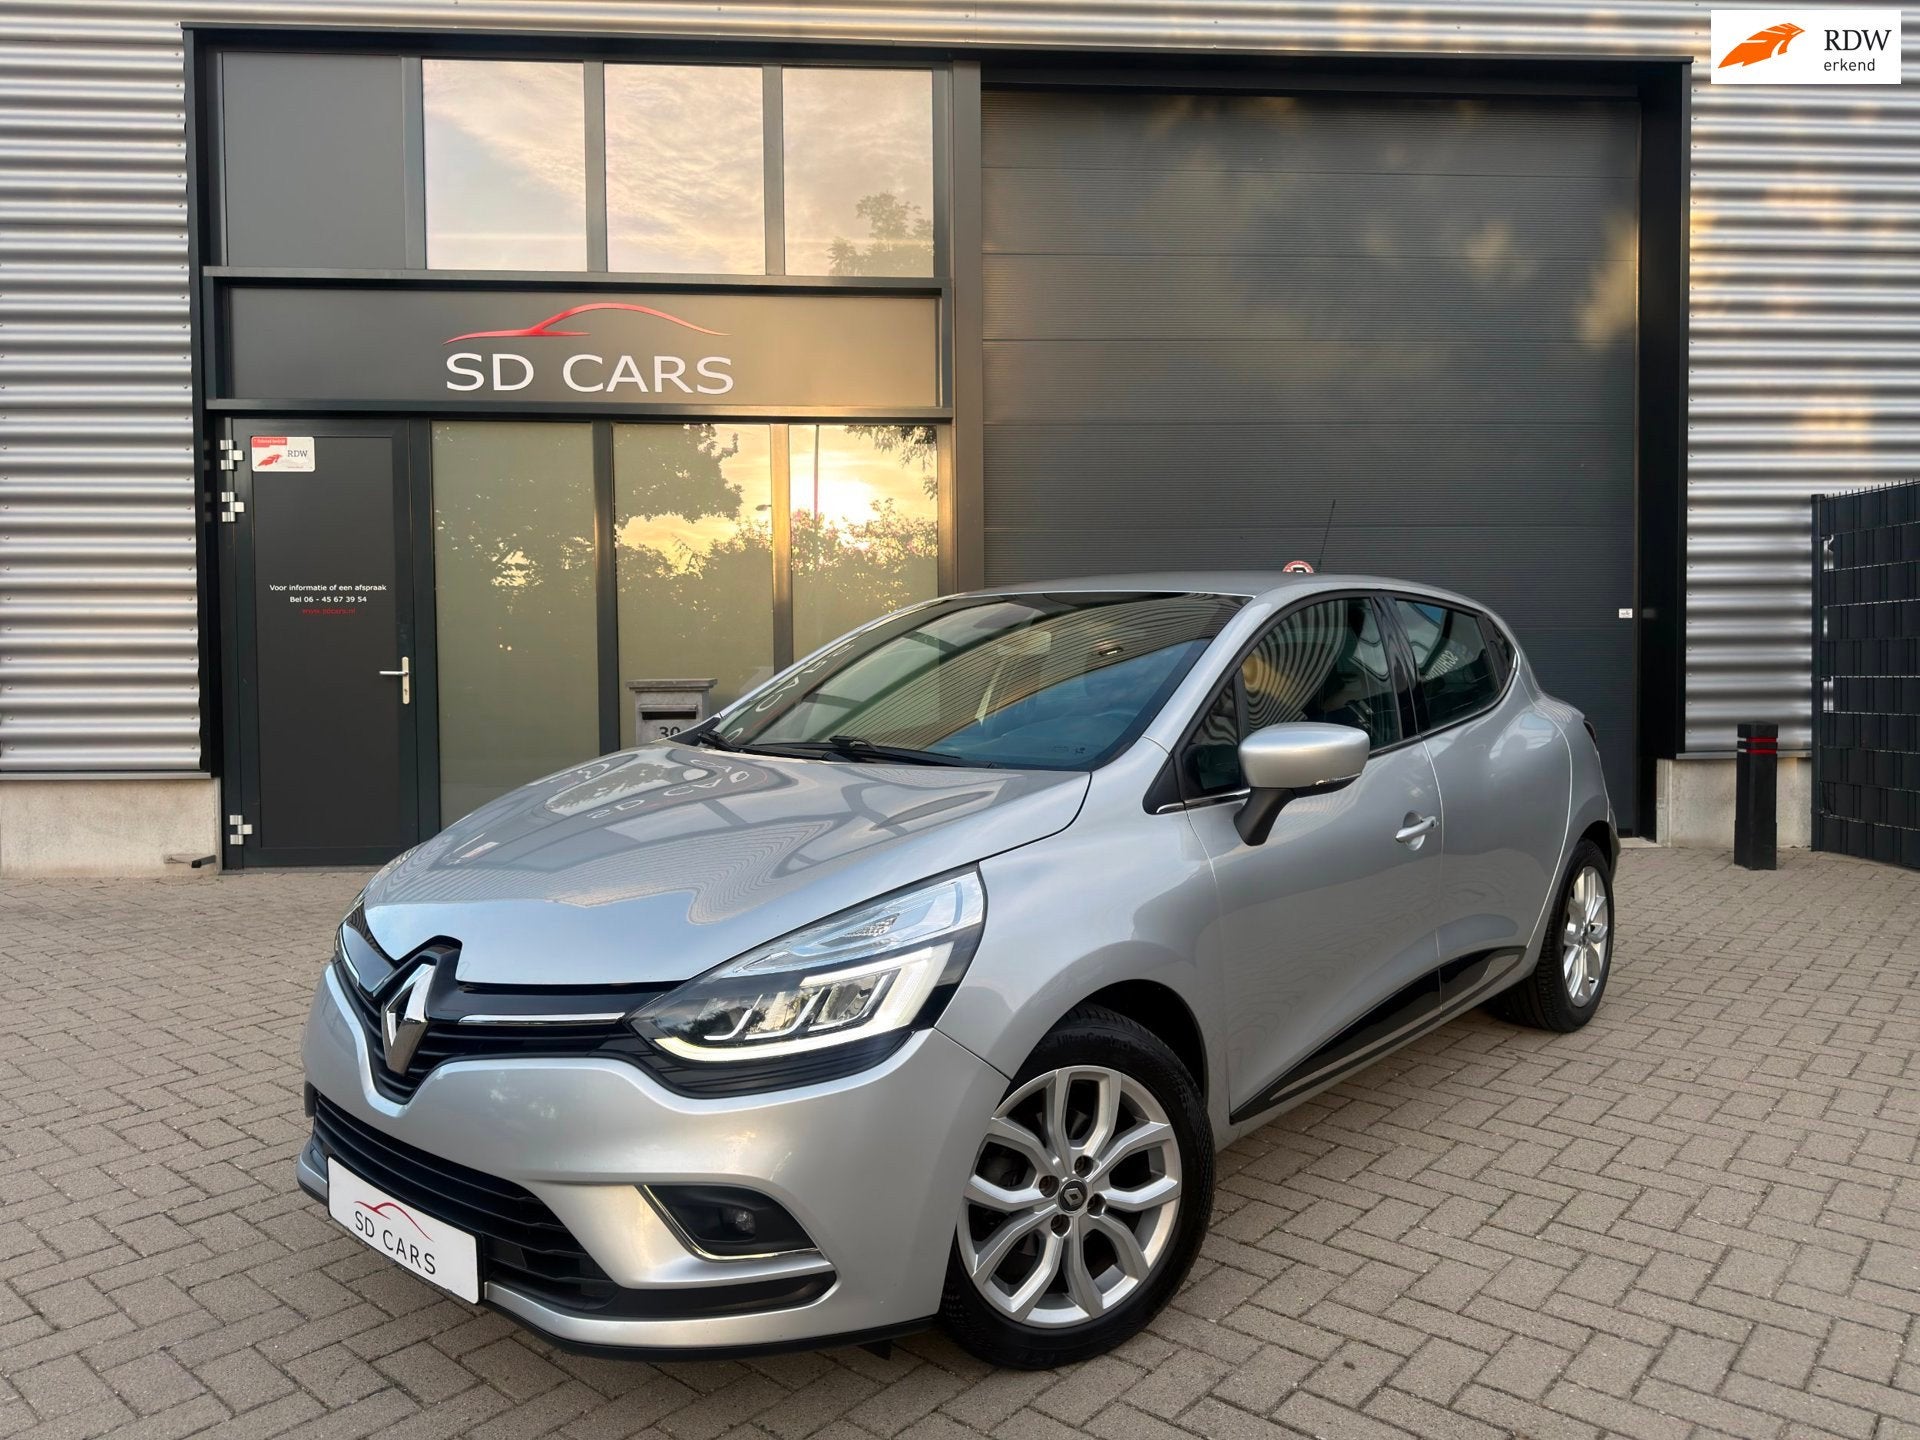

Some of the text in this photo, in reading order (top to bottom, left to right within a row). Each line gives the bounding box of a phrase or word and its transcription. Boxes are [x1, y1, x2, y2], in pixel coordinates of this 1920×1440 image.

[445, 352, 734, 395] SD CARS
[287, 449, 308, 458] RDW
[354, 584, 387, 592] afspraak
[354, 1210, 437, 1275] SD CARS
